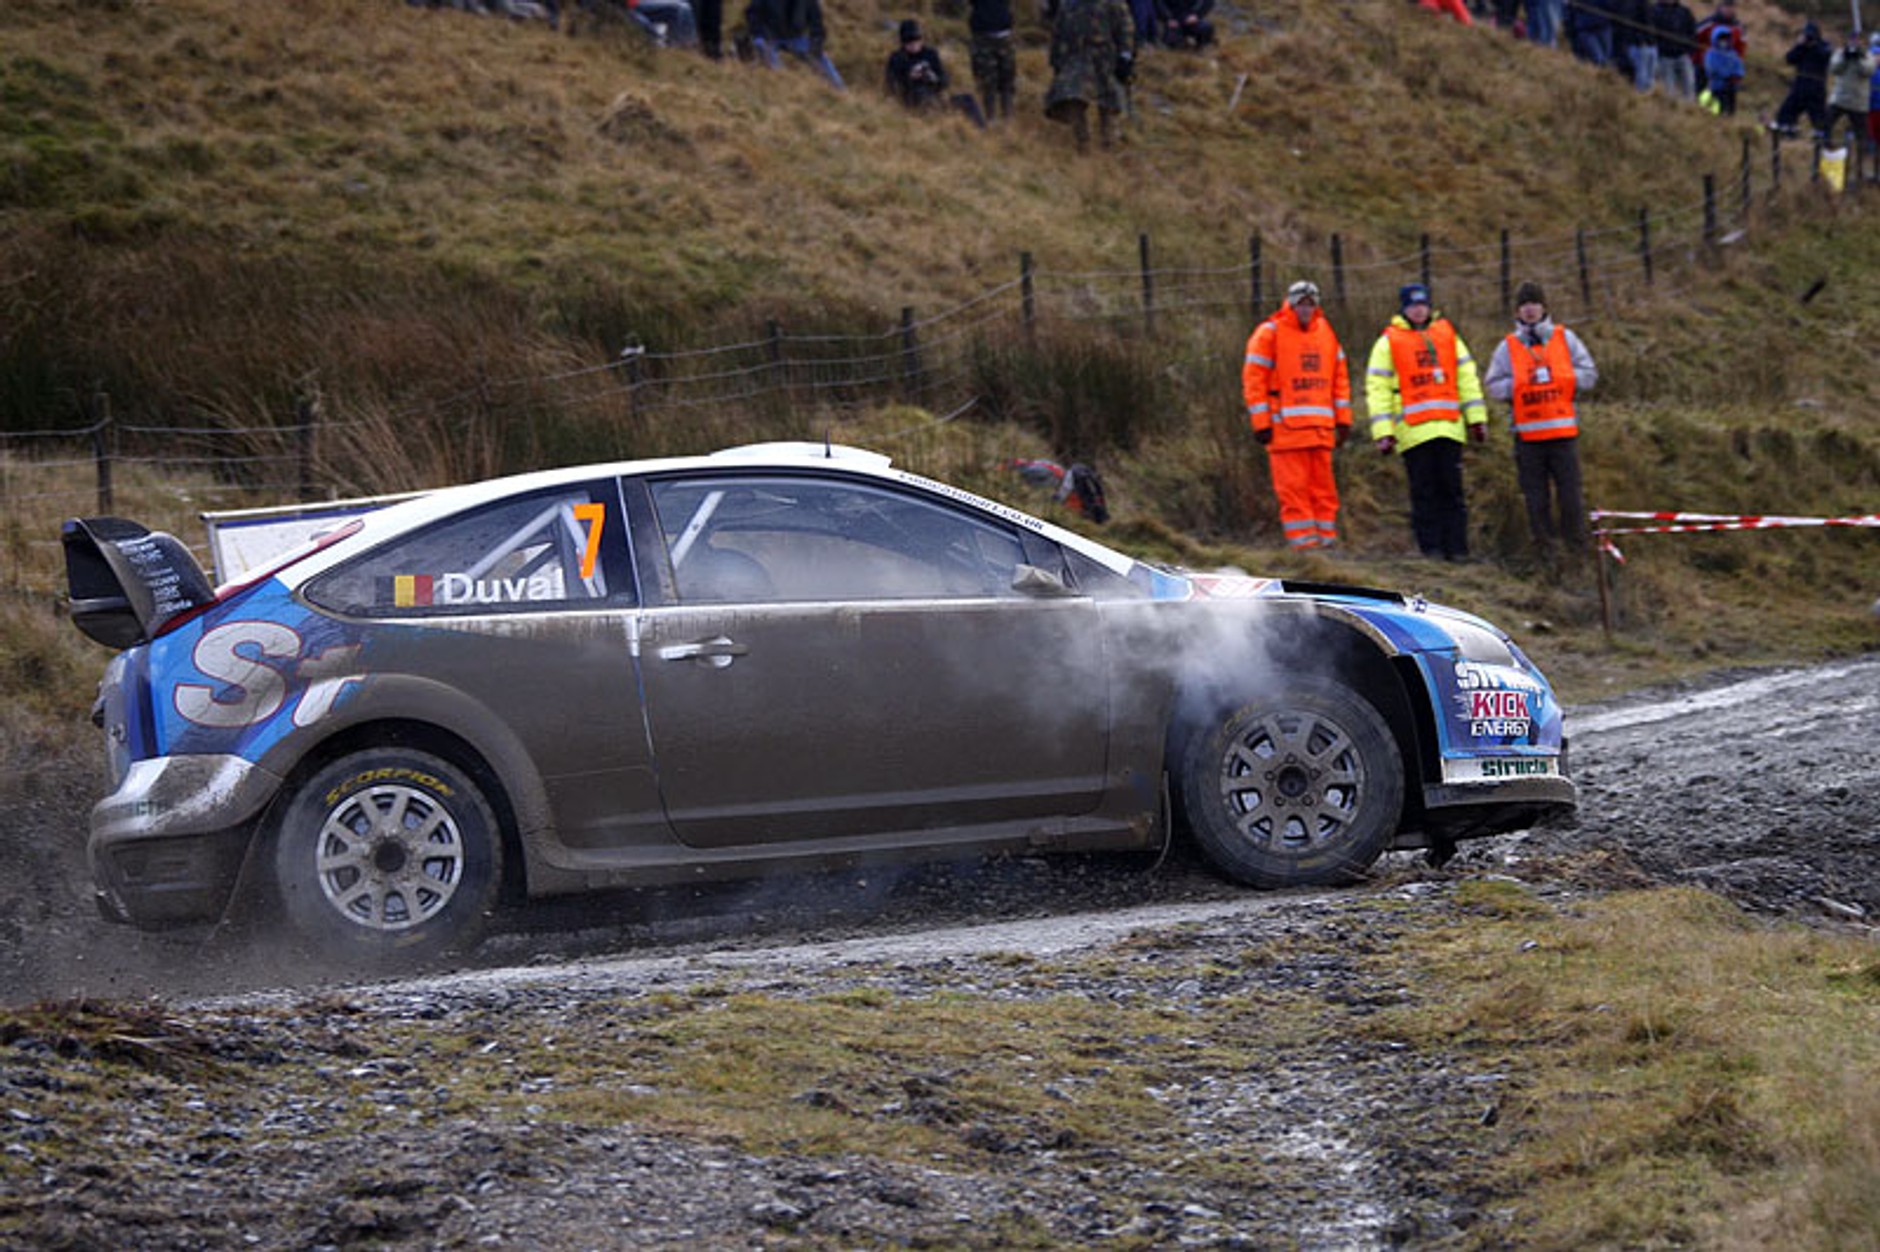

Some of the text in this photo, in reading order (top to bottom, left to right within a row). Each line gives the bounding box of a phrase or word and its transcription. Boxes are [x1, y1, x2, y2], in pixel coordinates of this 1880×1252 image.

[573, 502, 605, 580] 7
[443, 572, 567, 605] Duval
[1472, 691, 1530, 718] KICK
[1470, 719, 1530, 738] ENERGY
